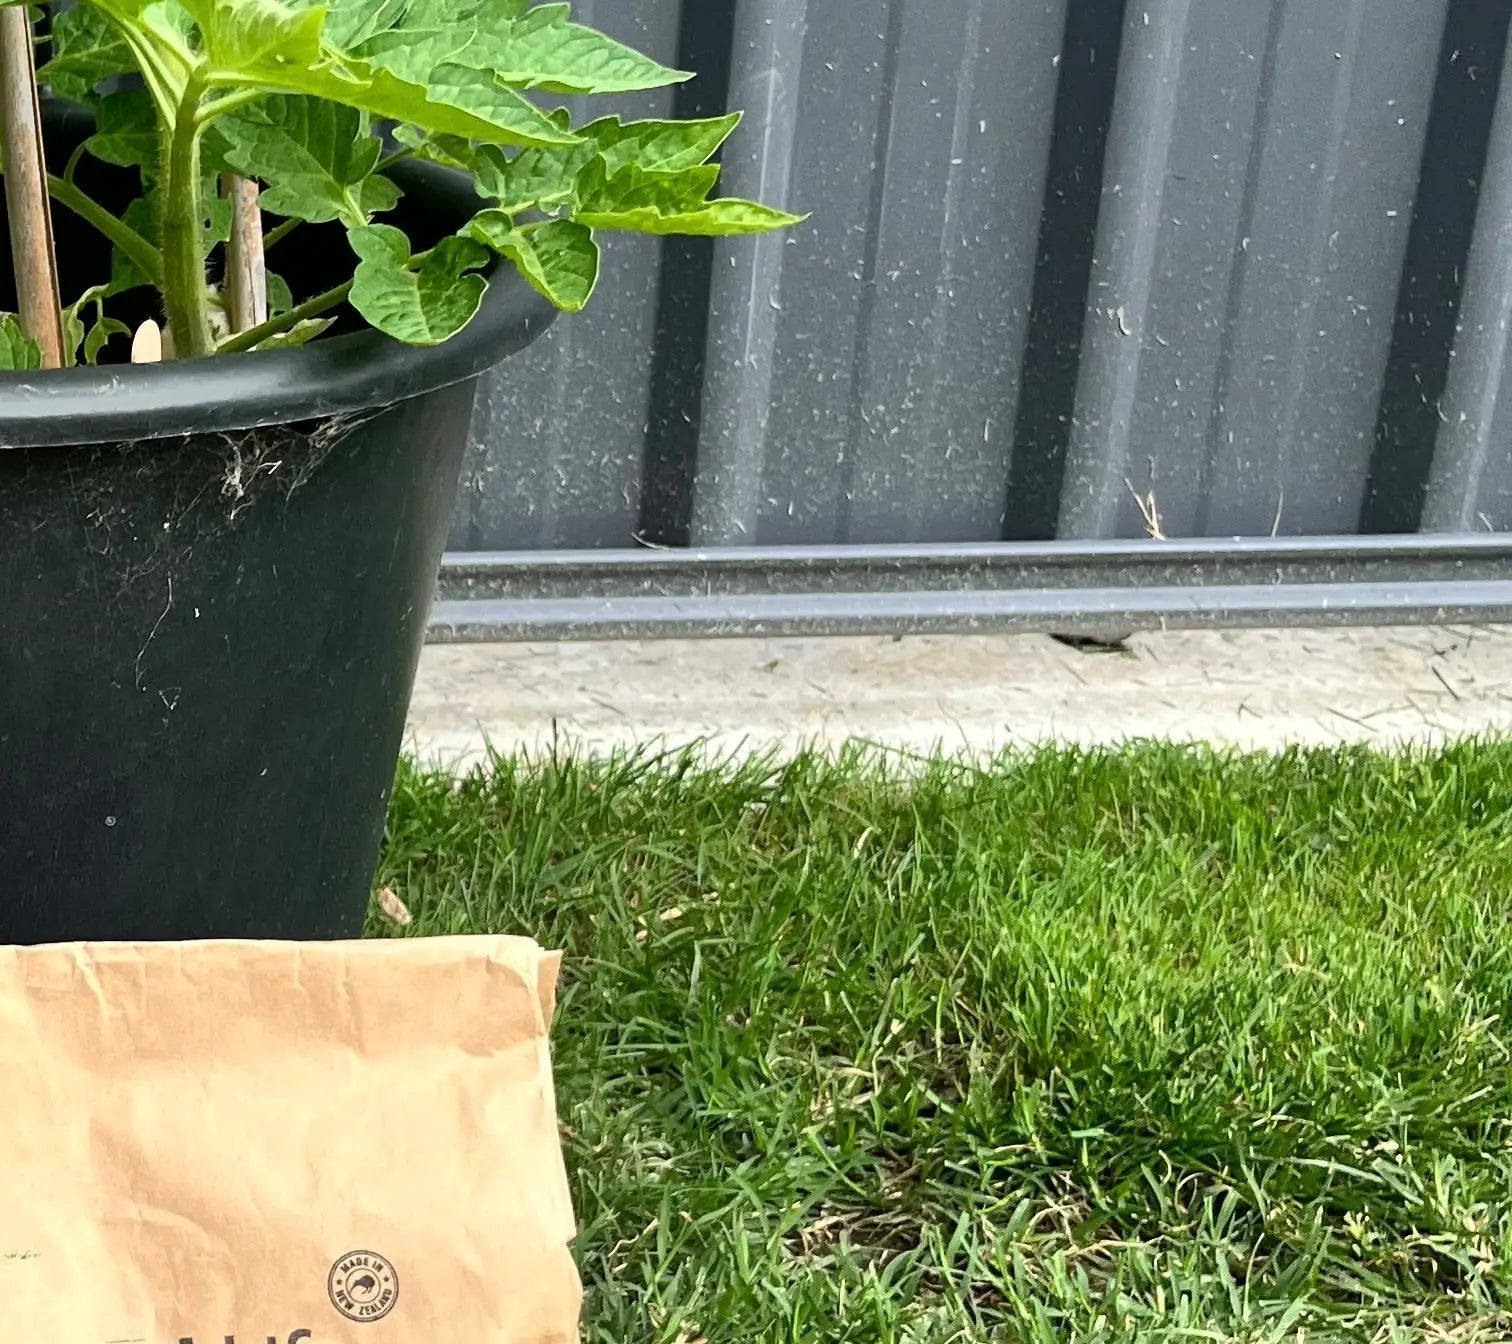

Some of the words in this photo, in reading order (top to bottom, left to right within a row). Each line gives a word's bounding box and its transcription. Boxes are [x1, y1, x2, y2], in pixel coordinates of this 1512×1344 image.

[339, 1256, 369, 1274] MADE
[371, 1260, 384, 1273] IN
[335, 1289, 355, 1310] NEW
[358, 1288, 393, 1316] ZEALAND
